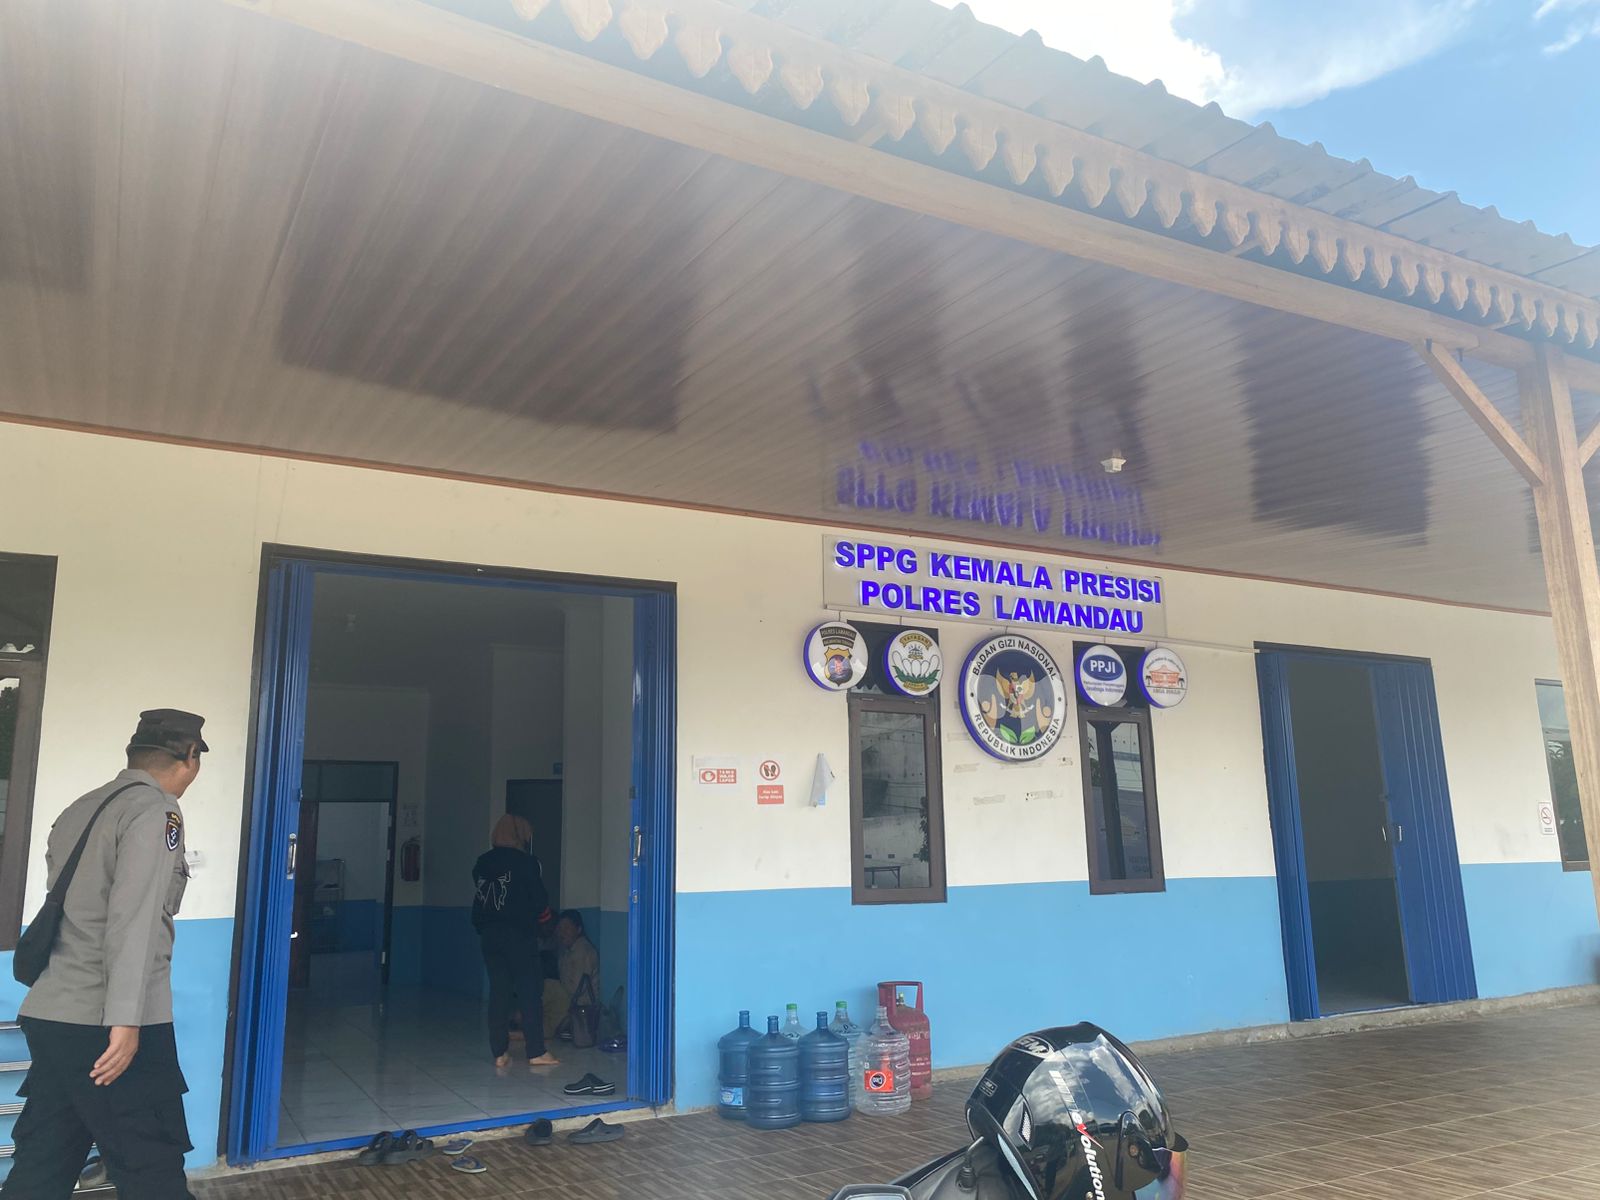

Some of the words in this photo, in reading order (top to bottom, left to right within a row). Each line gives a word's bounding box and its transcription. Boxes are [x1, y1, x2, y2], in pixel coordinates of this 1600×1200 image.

[834, 540, 918, 574] SPPG
[929, 551, 1052, 591] KEMALA
[1062, 568, 1162, 604] PRESISI
[860, 580, 981, 617] POLRES
[993, 594, 1144, 634] LAMANDAU
[972, 644, 997, 676] BADAN
[998, 638, 1016, 650] GIZI
[1017, 640, 1058, 681] NASIONAL
[1090, 660, 1116, 674] PPJI
[974, 713, 1016, 756] REPUBLIK
[1018, 718, 1060, 757] INDONESIA
[1071, 1111, 1106, 1200] evolution
